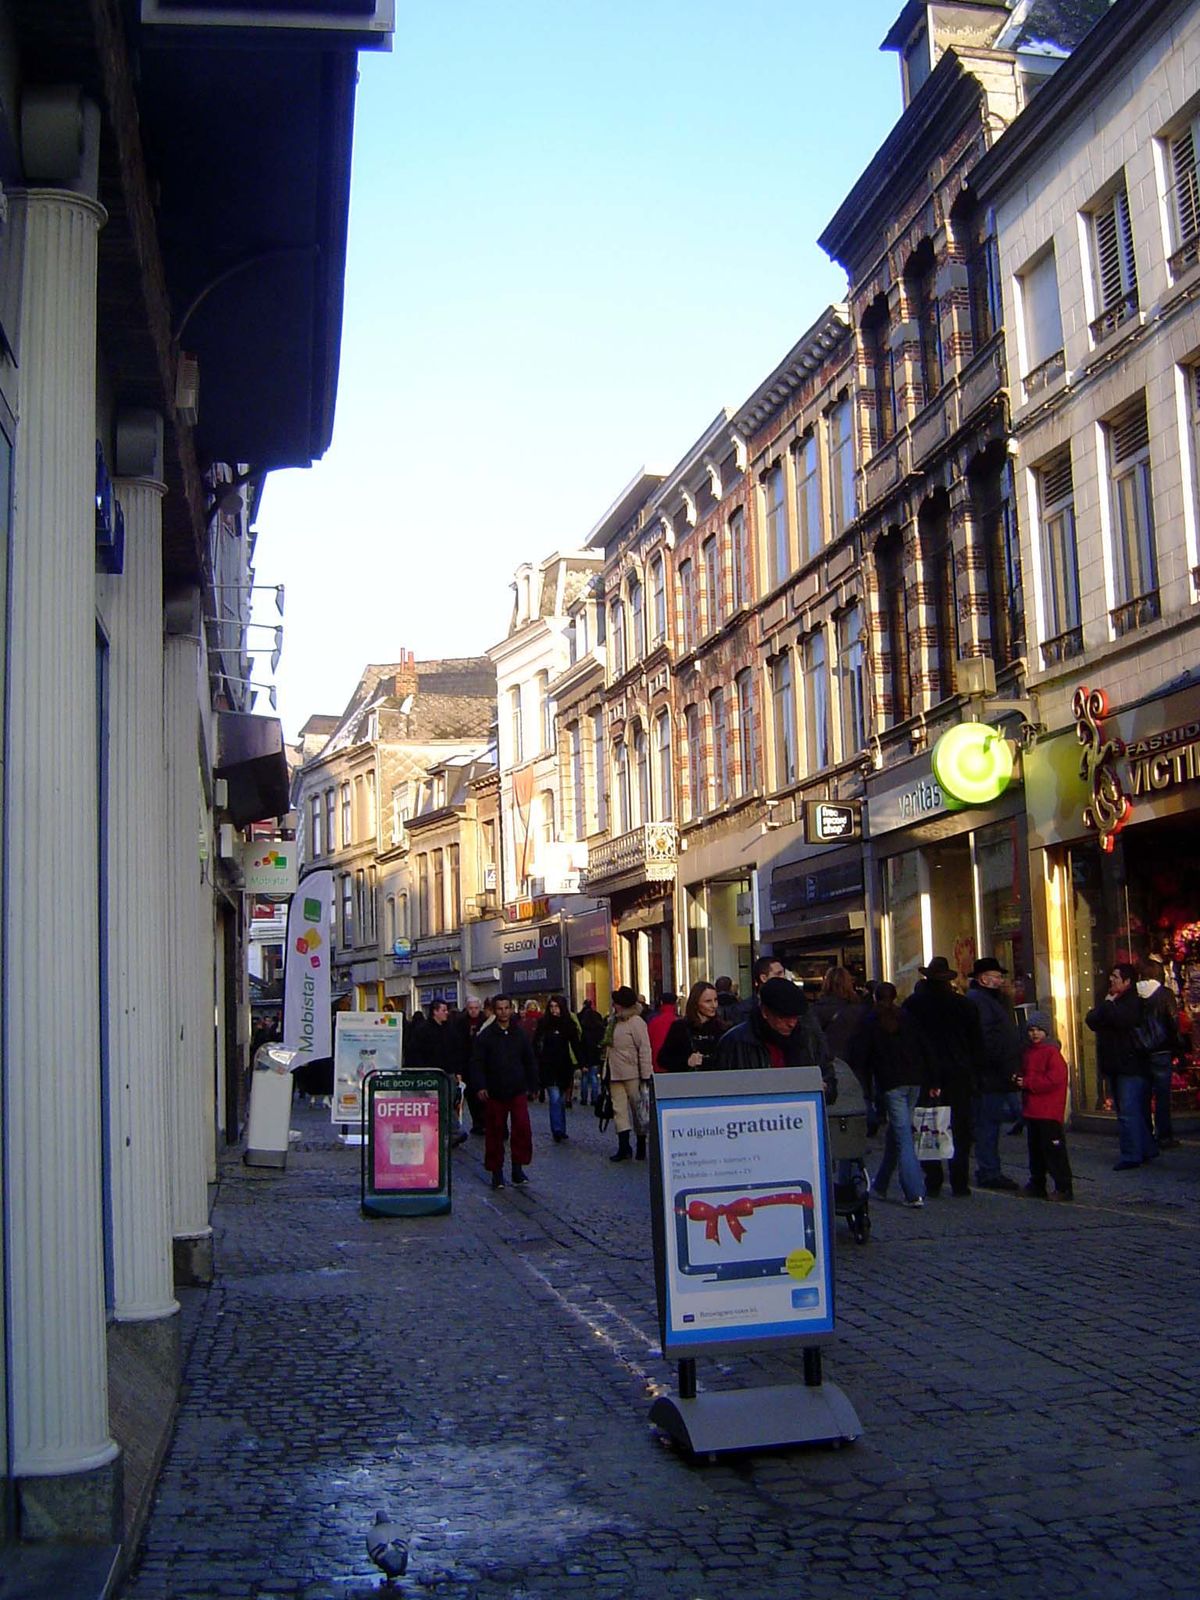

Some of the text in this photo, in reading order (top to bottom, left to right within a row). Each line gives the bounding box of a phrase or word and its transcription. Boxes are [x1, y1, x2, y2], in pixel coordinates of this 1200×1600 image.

[898, 781, 942, 818] veritas
[822, 806, 839, 816] free
[822, 815, 847, 825] record
[823, 824, 843, 834] shop
[251, 875, 289, 885] Mobistar
[299, 974, 315, 1052] Mobistar
[416, 1079, 439, 1087] SHOP
[671, 1114, 804, 1139] TV digitale gratuite
